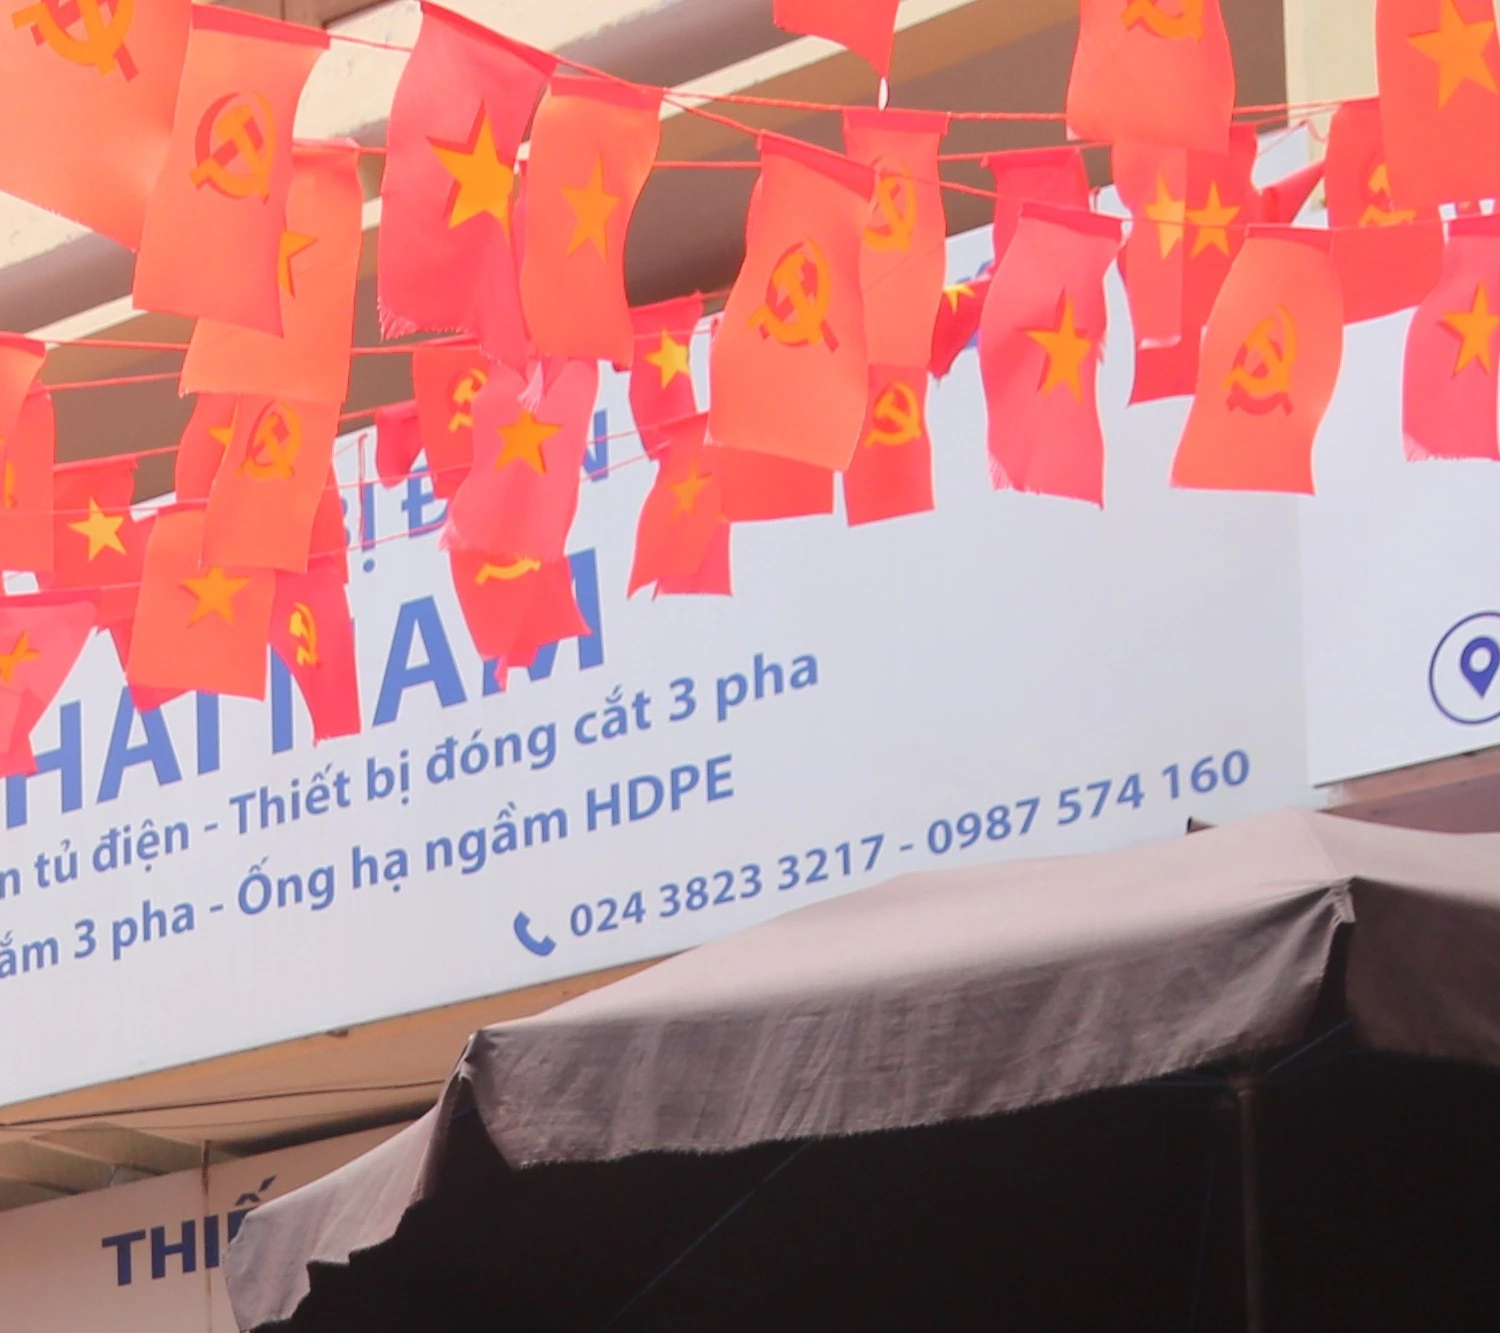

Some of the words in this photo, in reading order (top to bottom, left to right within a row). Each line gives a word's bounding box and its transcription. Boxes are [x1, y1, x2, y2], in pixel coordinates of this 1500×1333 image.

[33, 839, 79, 889] tủ
[92, 818, 190, 873] điện
[229, 763, 352, 836] Thiết
[366, 749, 412, 806] bị
[425, 722, 558, 785] đóng
[573, 684, 653, 746] cắt
[668, 676, 698, 722] 3
[715, 652, 820, 722] pha
[72, 918, 98, 959] 3
[111, 898, 197, 961] pha
[237, 855, 337, 915] Ống
[351, 844, 410, 893] hạ
[425, 801, 569, 876] ngầm
[586, 753, 736, 833] HDPE
[569, 890, 648, 938] 024
[657, 862, 764, 920] 3823
[775, 833, 888, 893] 3217
[926, 796, 1044, 857] 0987
[1056, 773, 1146, 827] 574
[1161, 748, 1252, 801] 160
